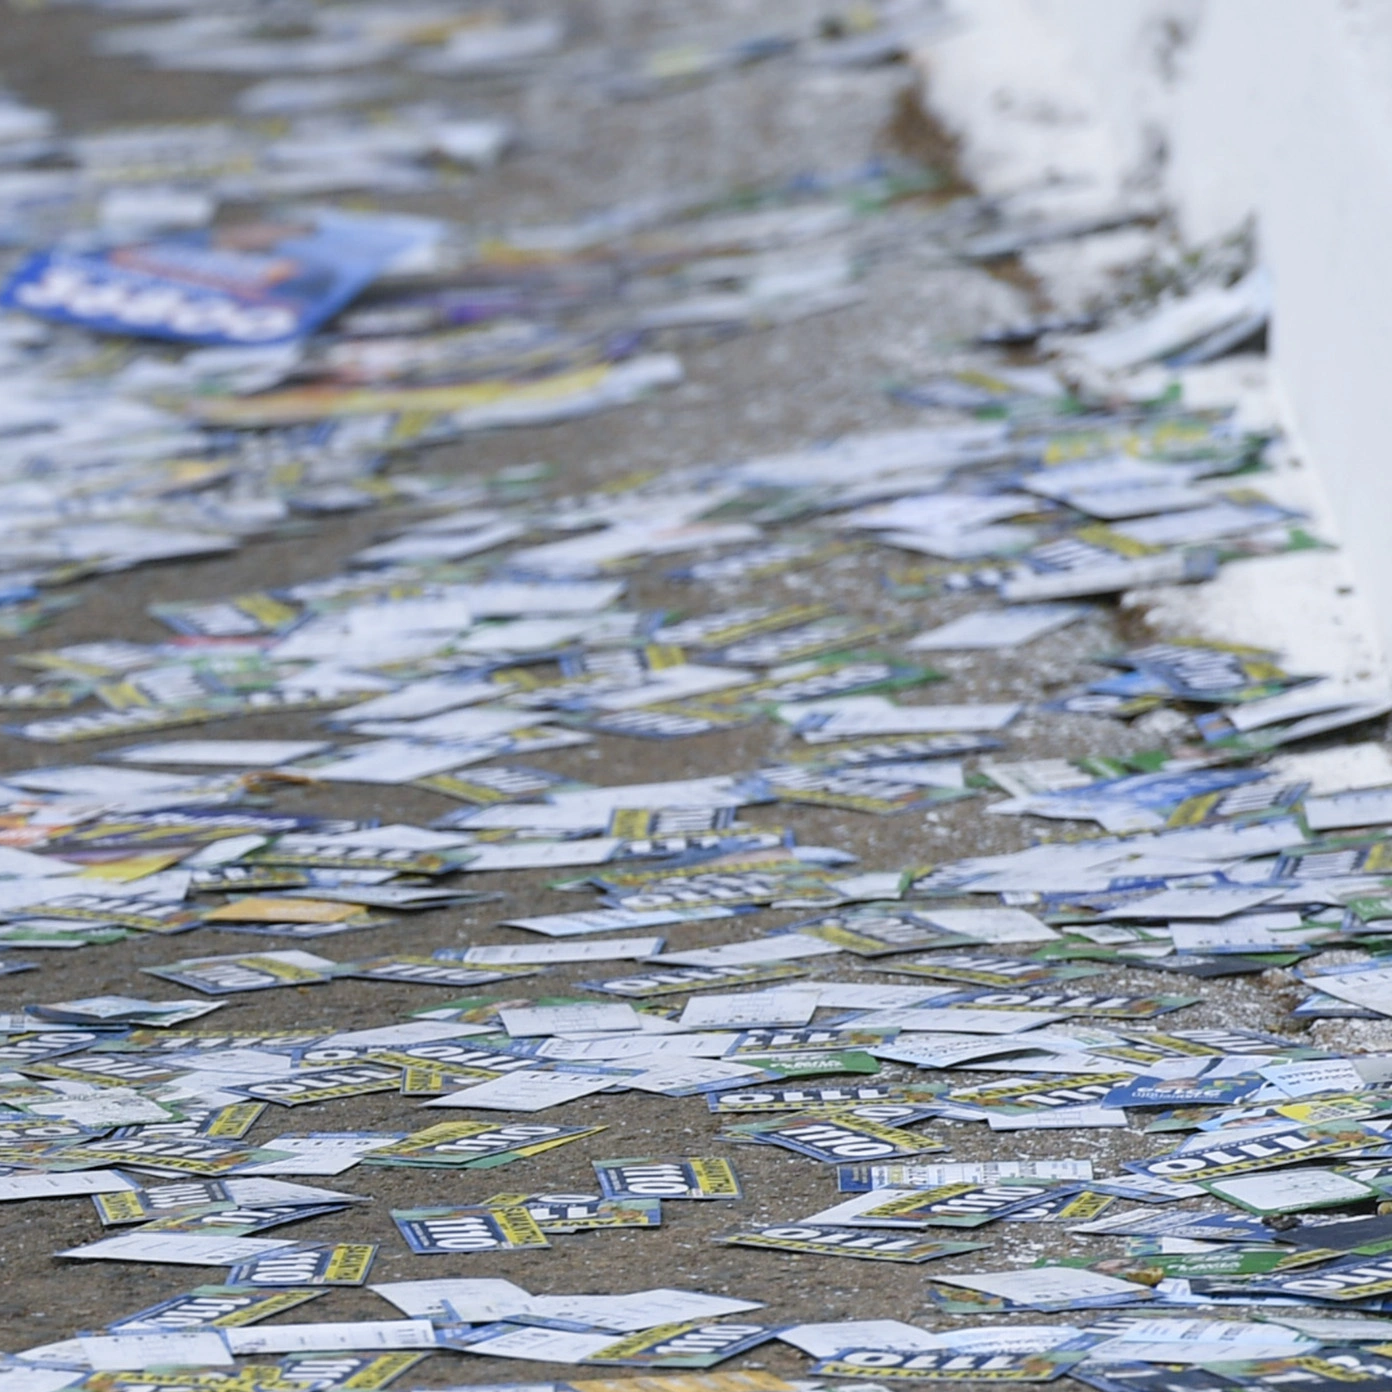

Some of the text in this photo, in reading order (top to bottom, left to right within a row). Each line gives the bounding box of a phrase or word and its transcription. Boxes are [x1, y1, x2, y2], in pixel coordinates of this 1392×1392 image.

[161, 1036, 314, 1048] 1110
[57, 1057, 173, 1079] 1110
[407, 1046, 539, 1071] 1110
[248, 1068, 401, 1095] 1110
[720, 1089, 890, 1104] 1110
[86, 1139, 234, 1159] 1110
[435, 1126, 561, 1151] 1110
[779, 1125, 896, 1157] 1110
[1147, 1135, 1317, 1174] 1110
[621, 1163, 690, 1195] 1110
[144, 1183, 211, 1209] 1110
[931, 1187, 1046, 1213] 1110
[424, 1217, 498, 1248] 1110
[761, 1227, 916, 1251] 1110
[252, 1252, 320, 1283] 1110
[166, 1297, 251, 1327] 1110
[654, 1325, 763, 1354] 1110
[843, 1352, 1016, 1370] 1110
